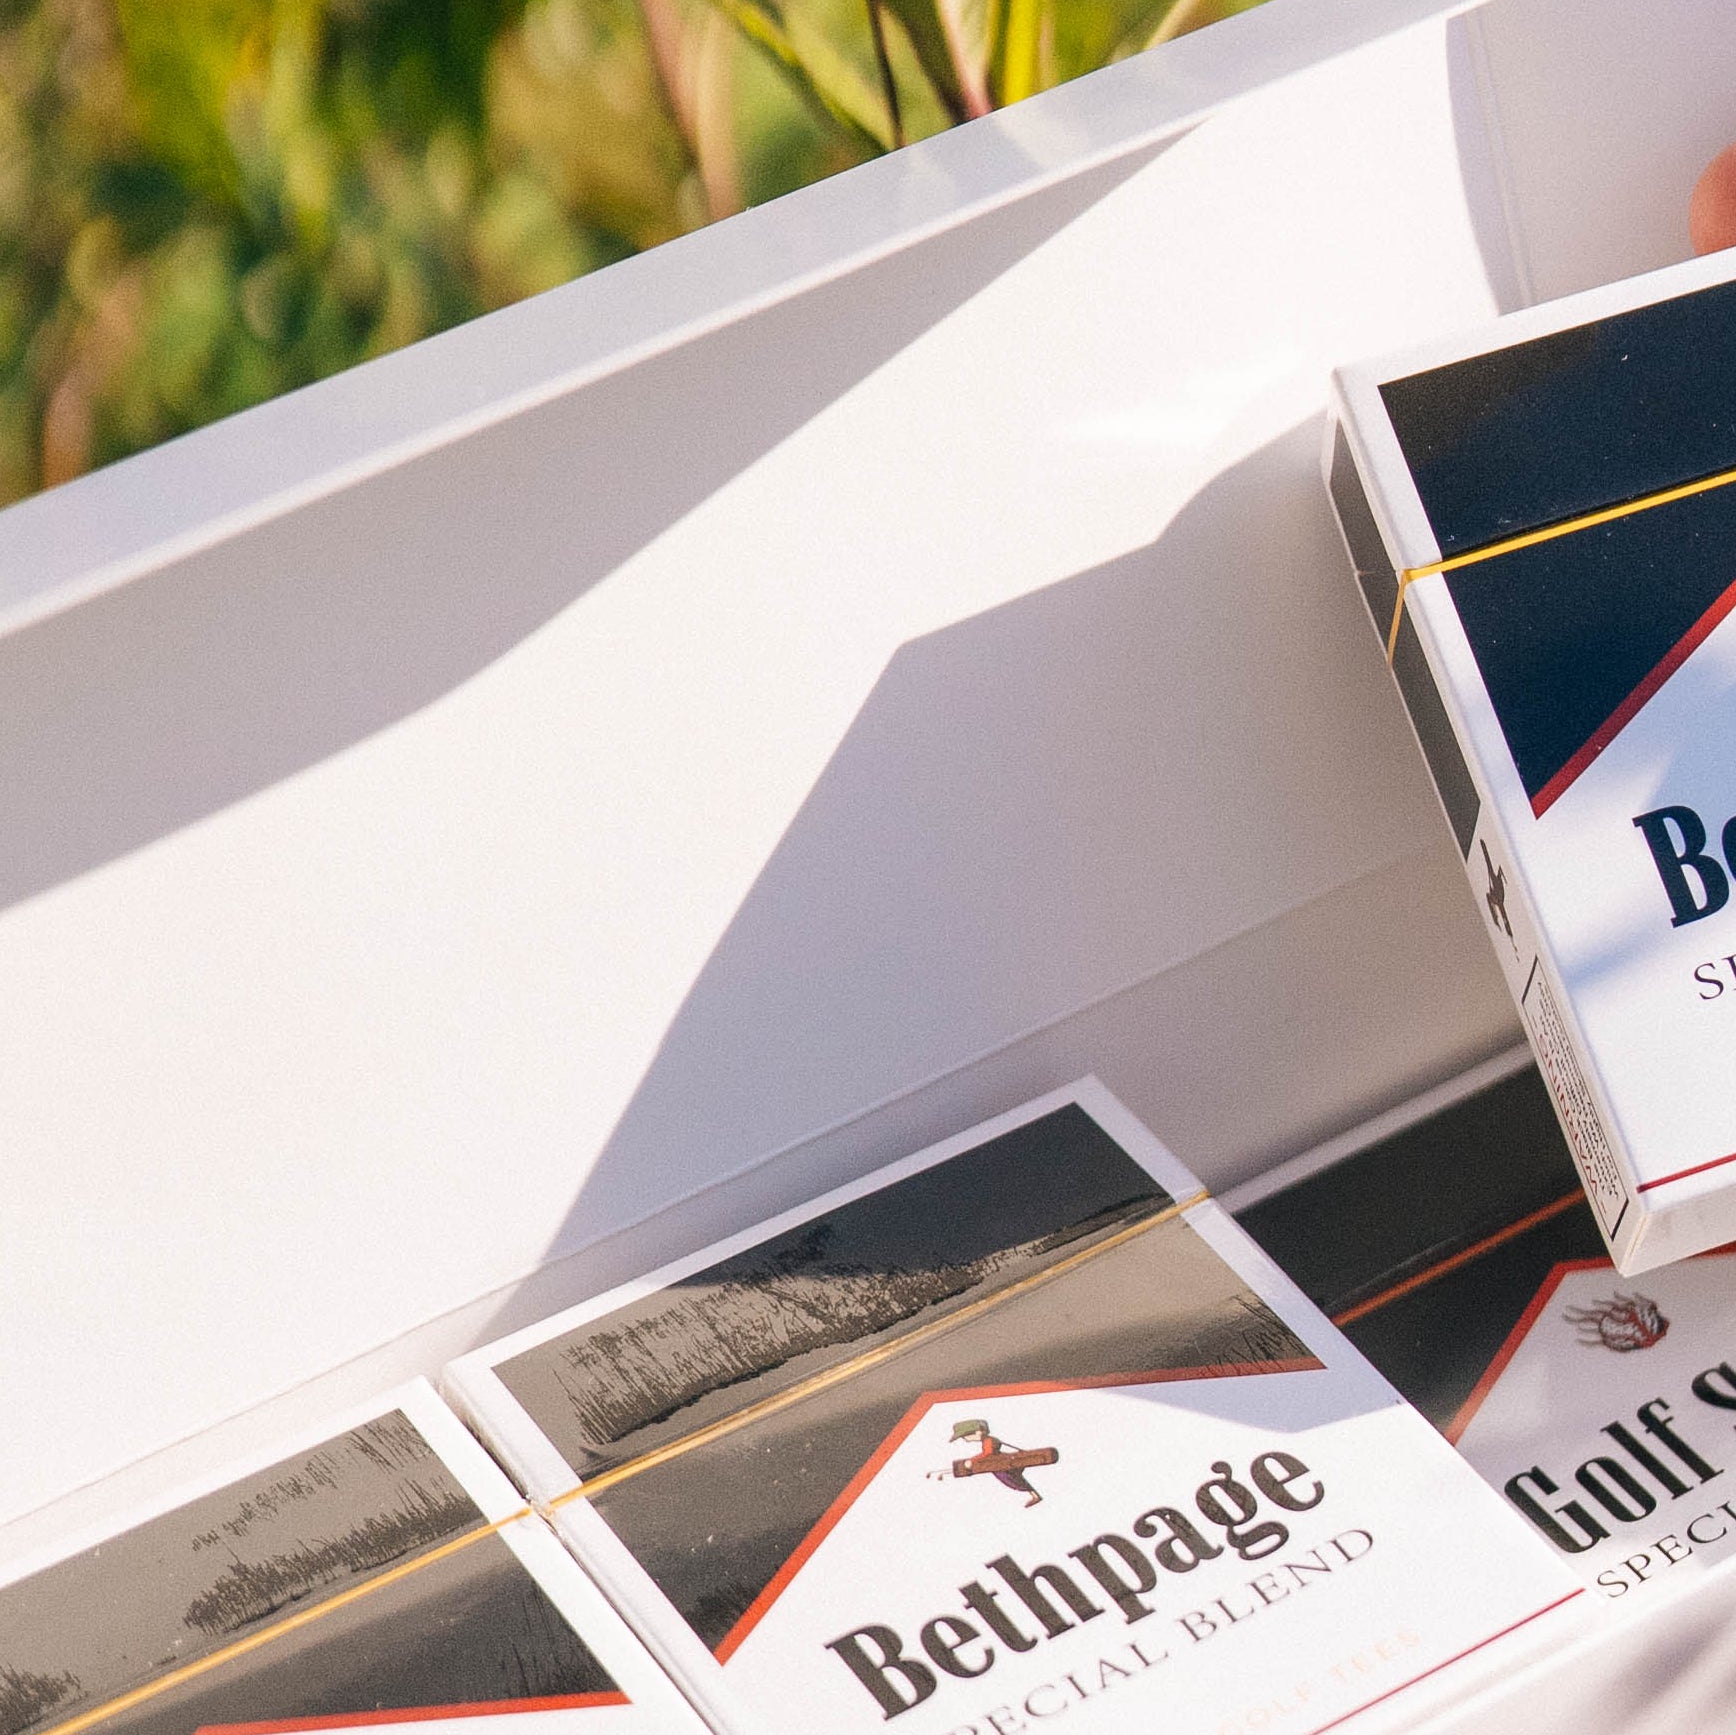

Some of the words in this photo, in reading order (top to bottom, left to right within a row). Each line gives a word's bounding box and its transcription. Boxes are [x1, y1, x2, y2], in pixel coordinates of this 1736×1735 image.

[1537, 1032, 1599, 1196] WARNING
[1503, 1397, 1725, 1558] Golf
[824, 1448, 1325, 1723] Bethpage
[1176, 1526, 1375, 1644] BLEND
